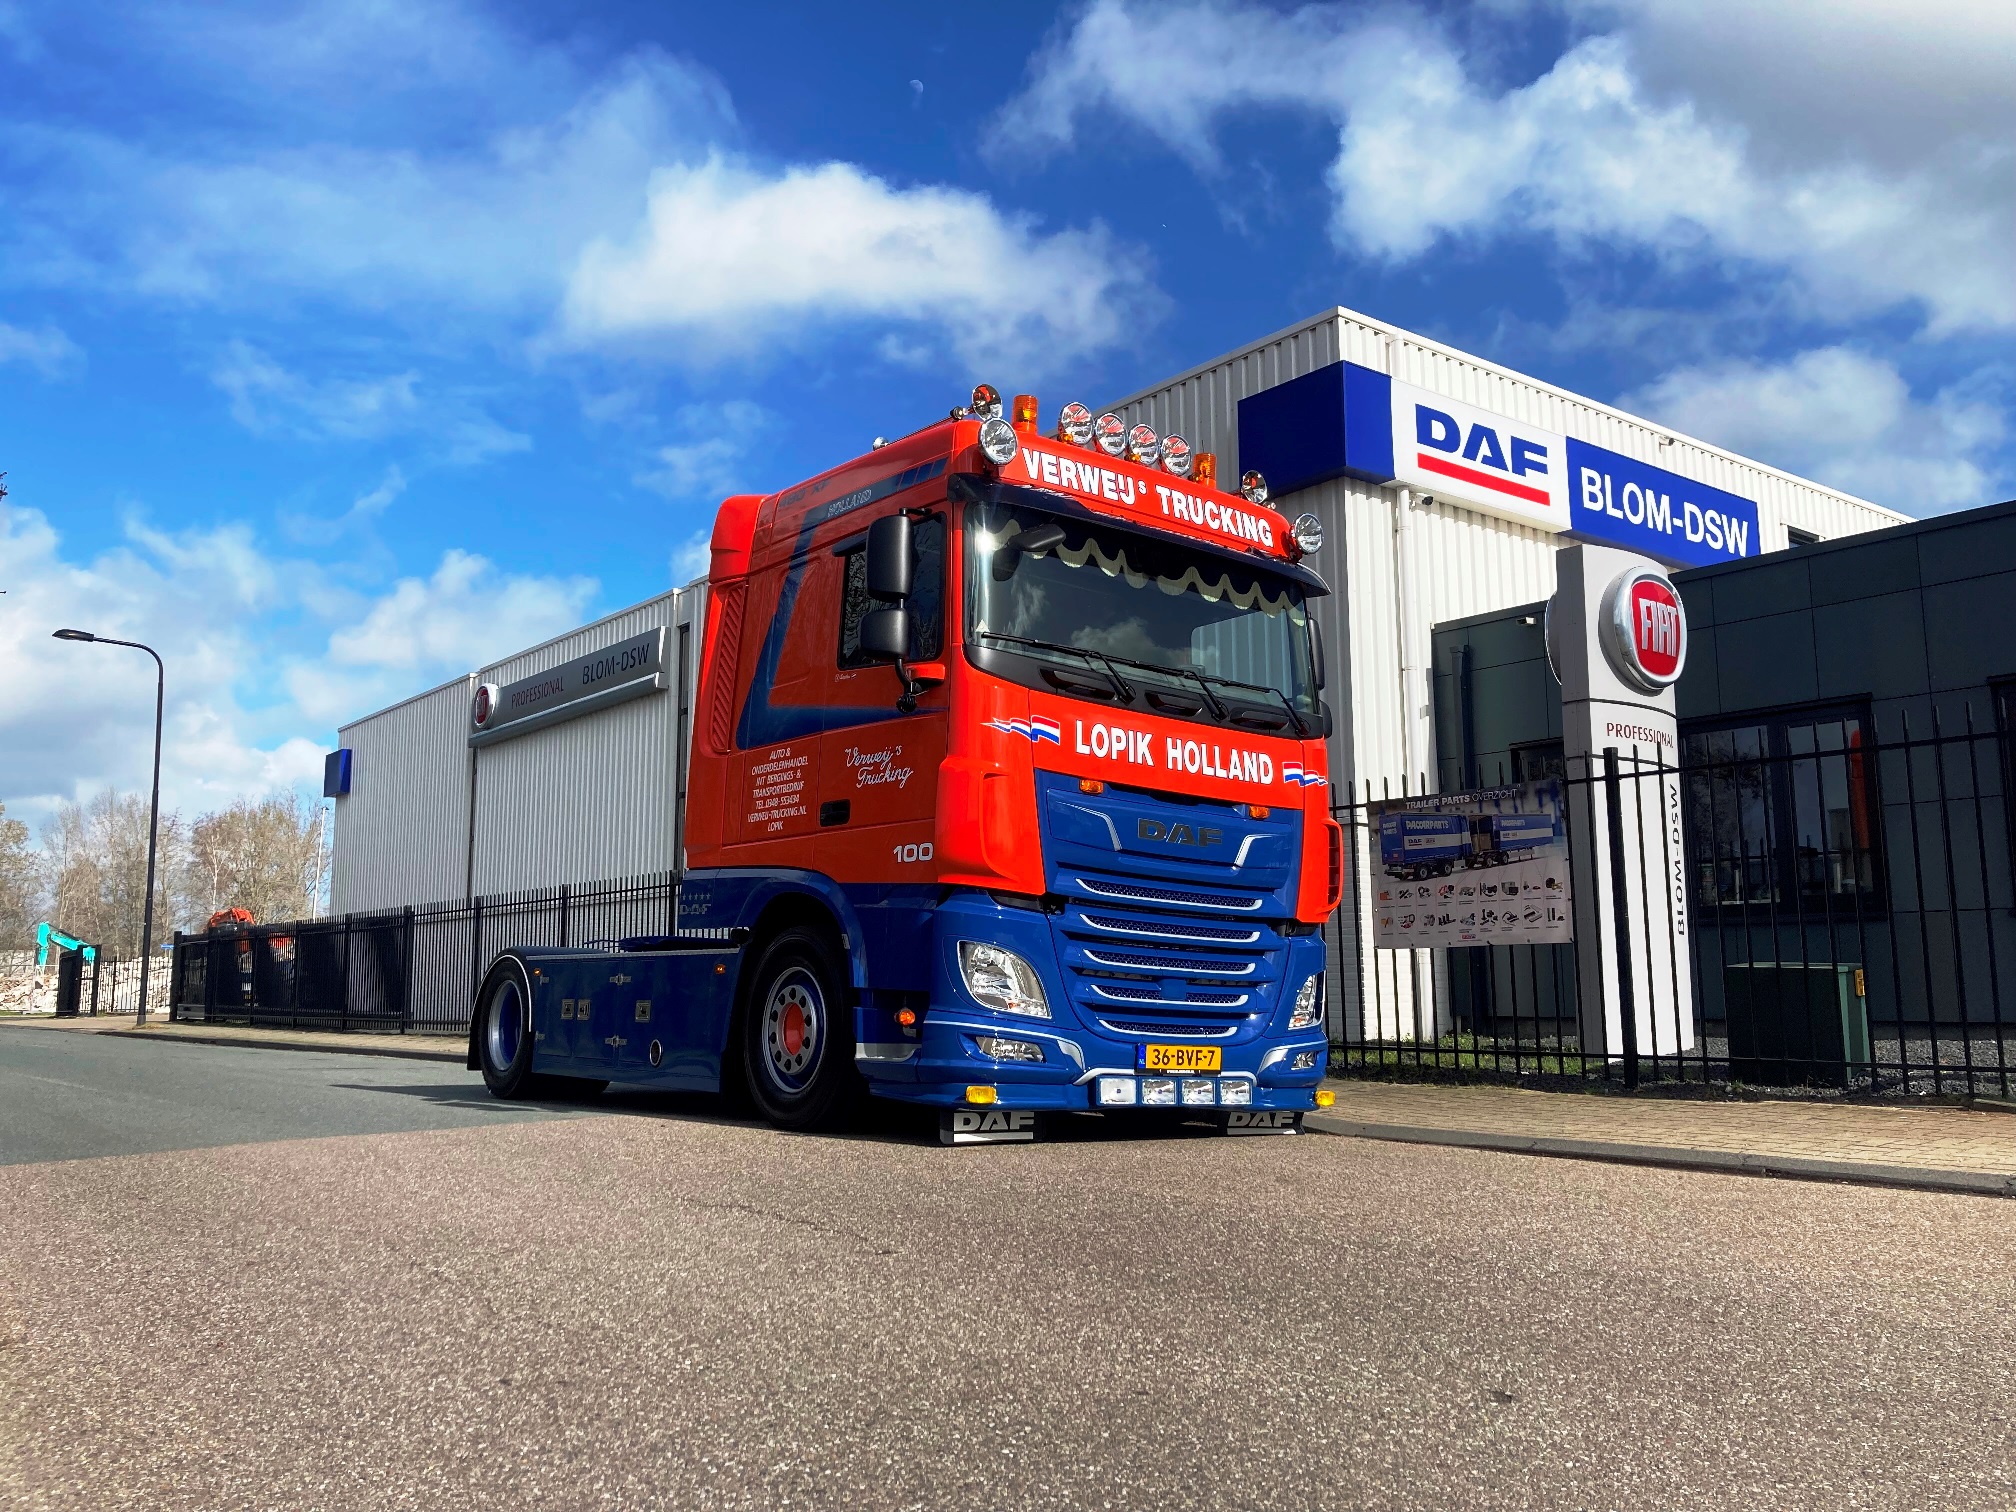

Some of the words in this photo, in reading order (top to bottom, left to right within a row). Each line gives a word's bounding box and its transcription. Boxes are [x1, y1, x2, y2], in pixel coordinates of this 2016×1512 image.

[1415, 403, 1549, 478] DAF
[1155, 484, 1274, 548] TRUCKING
[1580, 466, 1748, 557] BLOM-DSW
[1638, 597, 1678, 658] FIAT
[511, 677, 565, 709] PROFESSIONAL
[582, 643, 650, 685] BLOM-DSW
[1606, 722, 1674, 749] PROFESSIONAL
[769, 749, 785, 761] AUTO
[1075, 719, 1155, 767] LOPIK
[1165, 736, 1274, 785] HOLLAND
[856, 766, 914, 789] Trucking
[1405, 797, 1440, 810] TRAILER
[1441, 794, 1470, 806] PARTS
[1137, 818, 1223, 846] DAF
[893, 842, 934, 863] 100
[1669, 783, 1685, 936] BLOM-DSW
[1152, 1048, 1216, 1067] 36-BVF-7
[953, 1110, 1035, 1132] DAF
[1227, 1112, 1295, 1128] DAF
